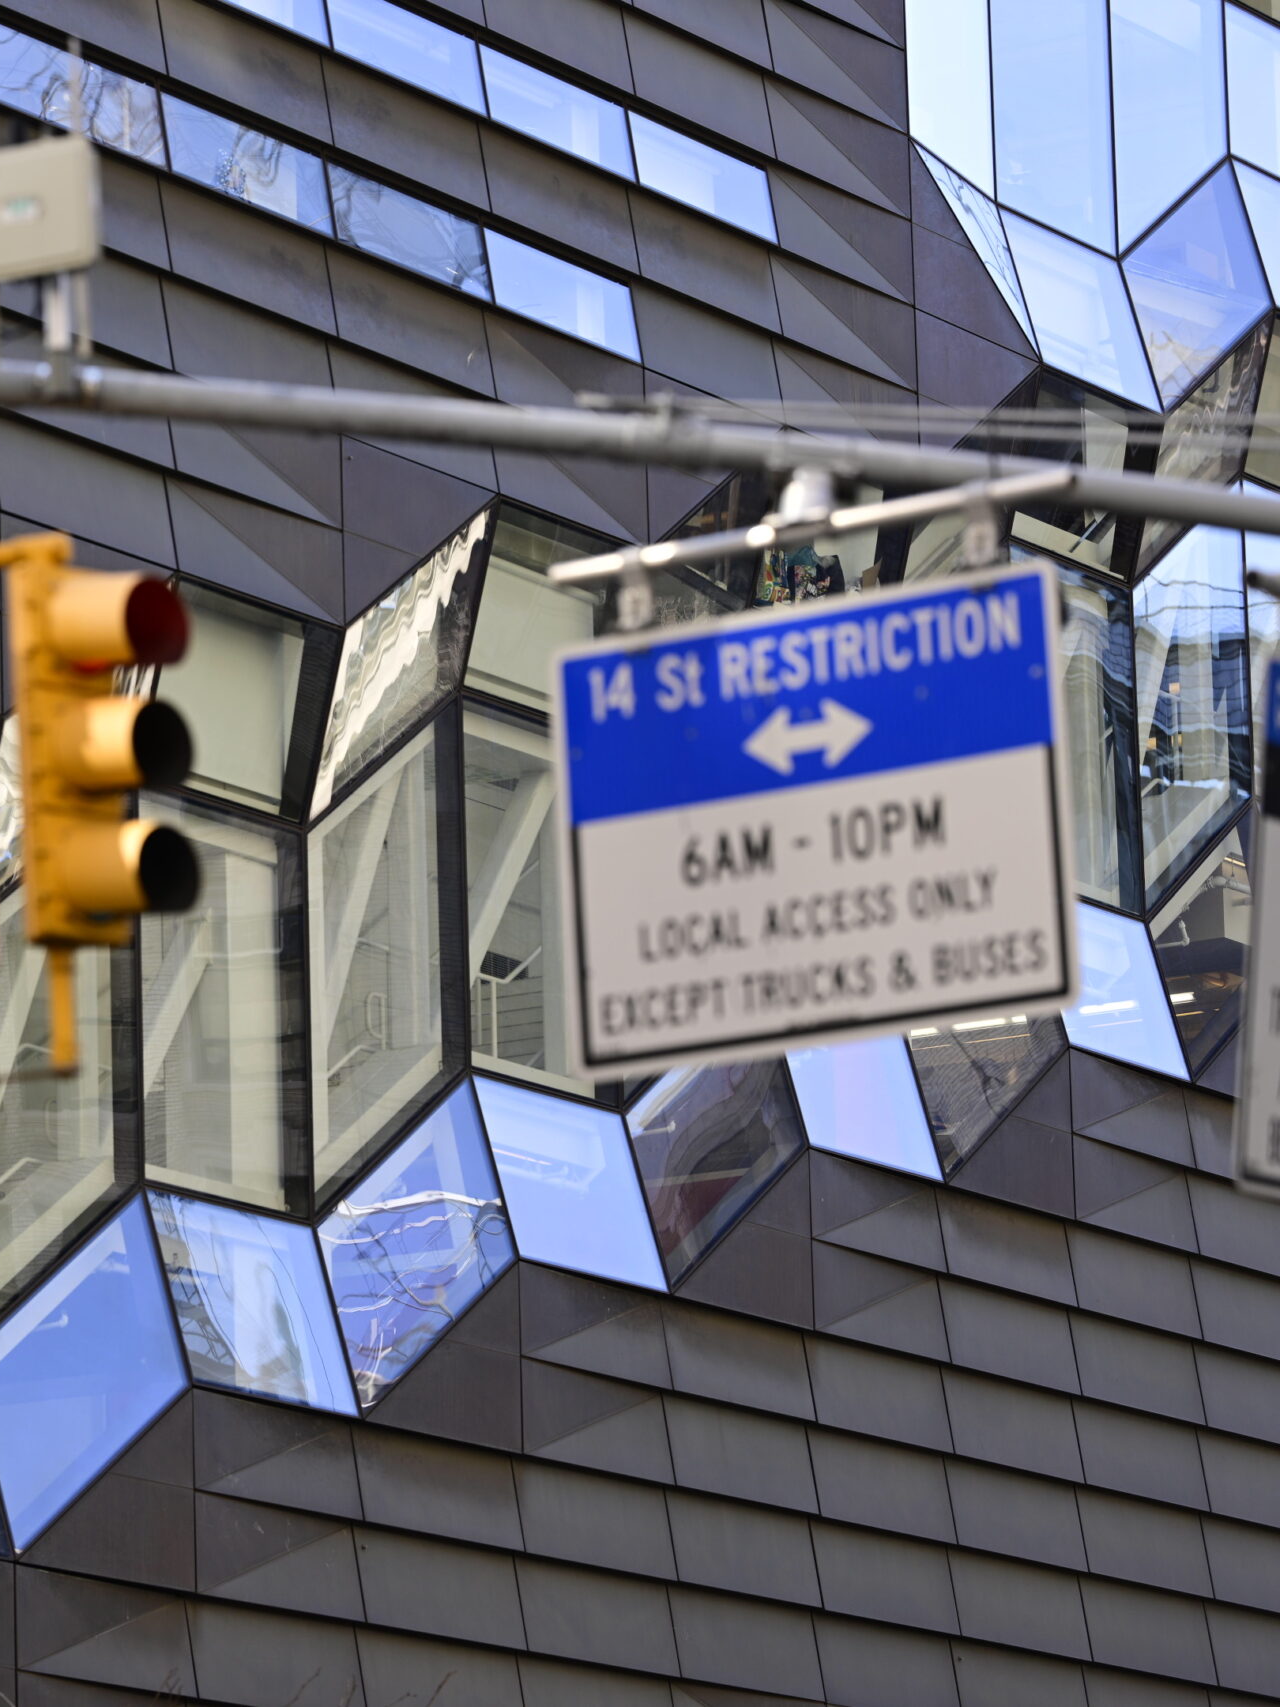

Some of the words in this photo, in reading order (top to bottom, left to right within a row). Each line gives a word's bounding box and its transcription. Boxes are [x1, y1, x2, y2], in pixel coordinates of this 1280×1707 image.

[588, 662, 636, 724] 14
[655, 649, 707, 714] St
[720, 591, 1021, 701] RESTRICTION
[681, 821, 776, 889] 6AM
[791, 834, 812, 851] -
[829, 795, 947, 865] 10PM
[637, 909, 749, 965] LOCAL
[761, 882, 898, 944] ACCESS
[907, 868, 999, 922] ONLY
[601, 976, 727, 1037] EXCEPT
[742, 954, 877, 1017] TRUCKS
[887, 951, 916, 993] &
[931, 929, 1048, 987] BUSES
